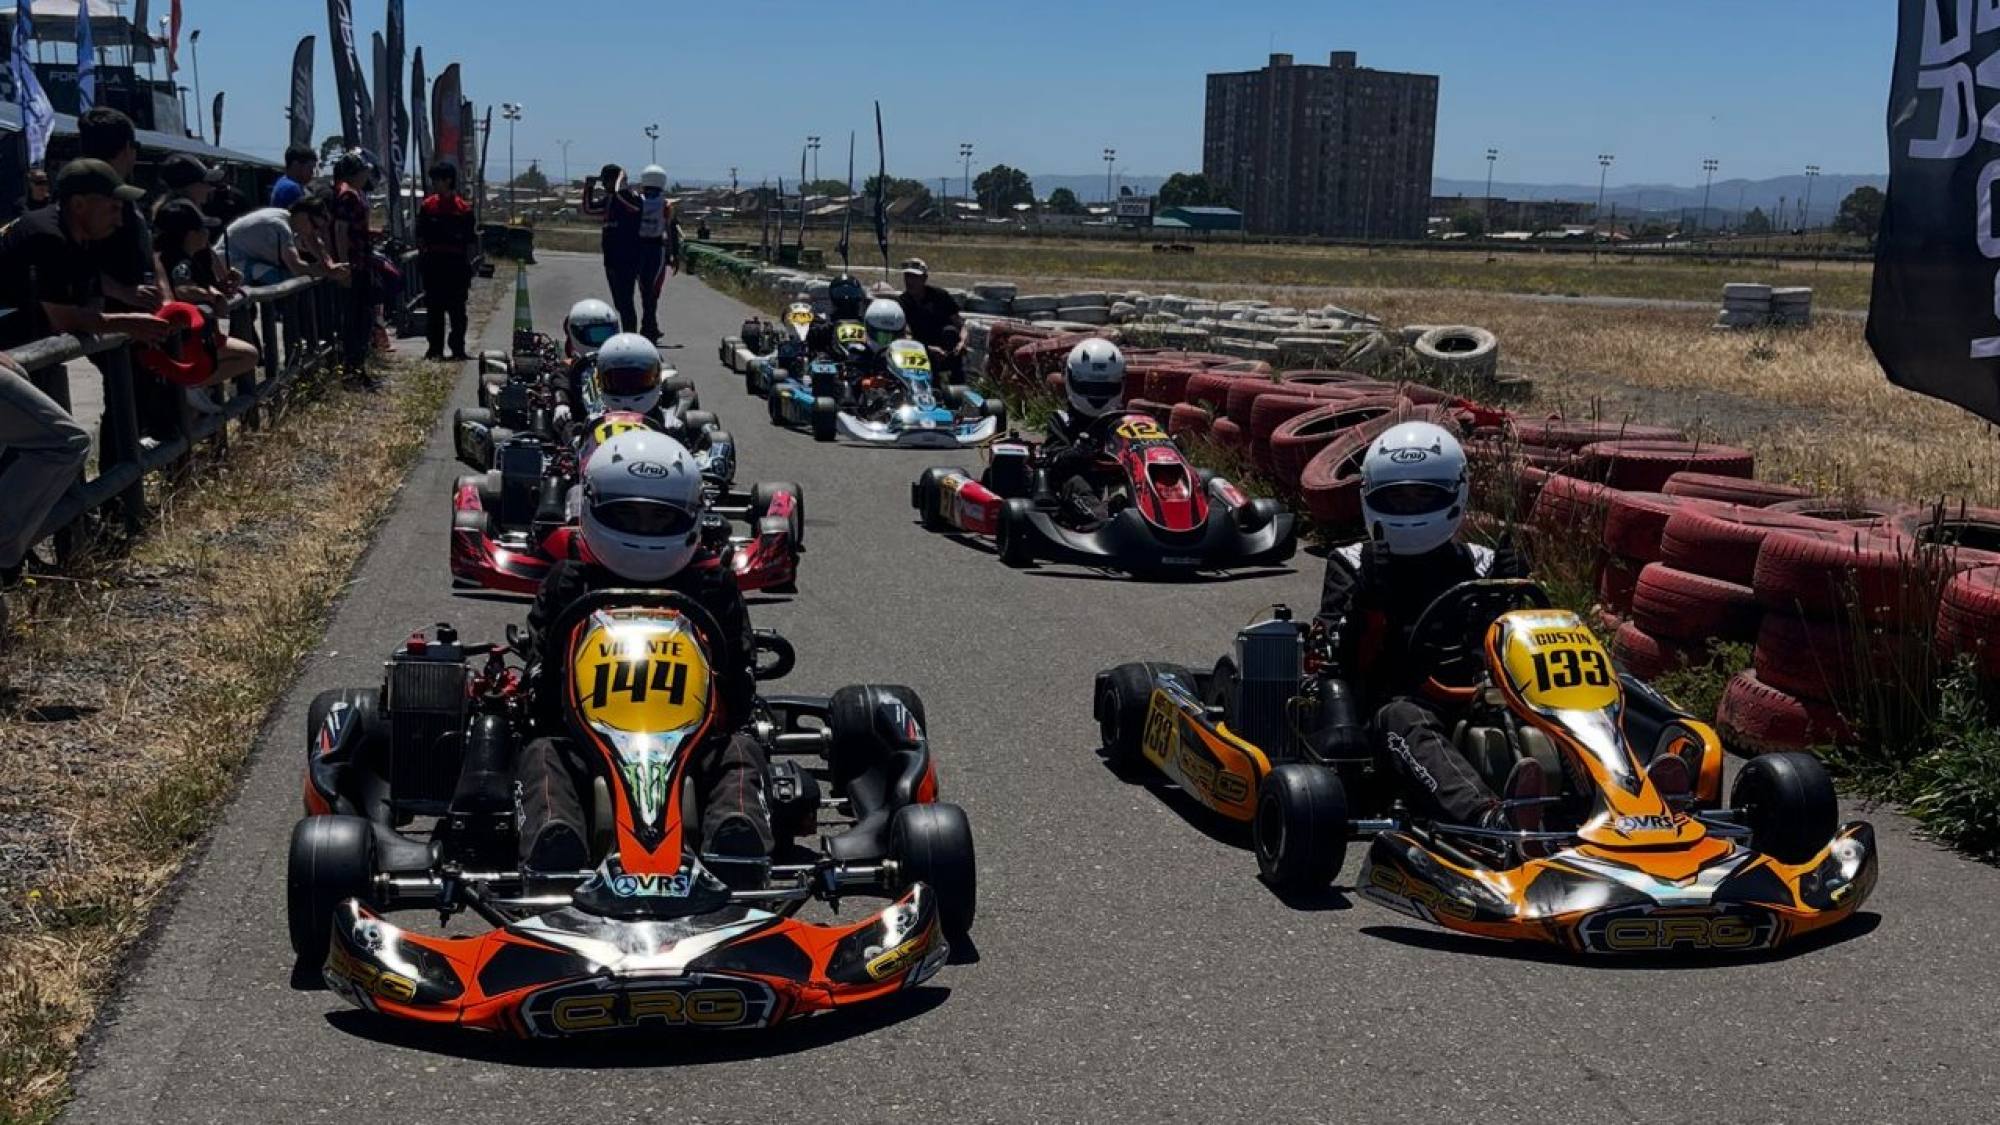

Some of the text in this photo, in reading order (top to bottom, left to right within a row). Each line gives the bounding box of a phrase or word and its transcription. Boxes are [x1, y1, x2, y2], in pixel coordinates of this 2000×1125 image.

[633, 462, 664, 475] Arai
[599, 639, 685, 657] VINTE
[1528, 631, 1592, 646] GUSTIN
[1532, 648, 1609, 692] 133
[593, 660, 687, 709] 144
[1636, 814, 1674, 829] VRS
[639, 874, 688, 893] VRS
[1605, 915, 1757, 950] CRG
[553, 989, 747, 1031] CRG
